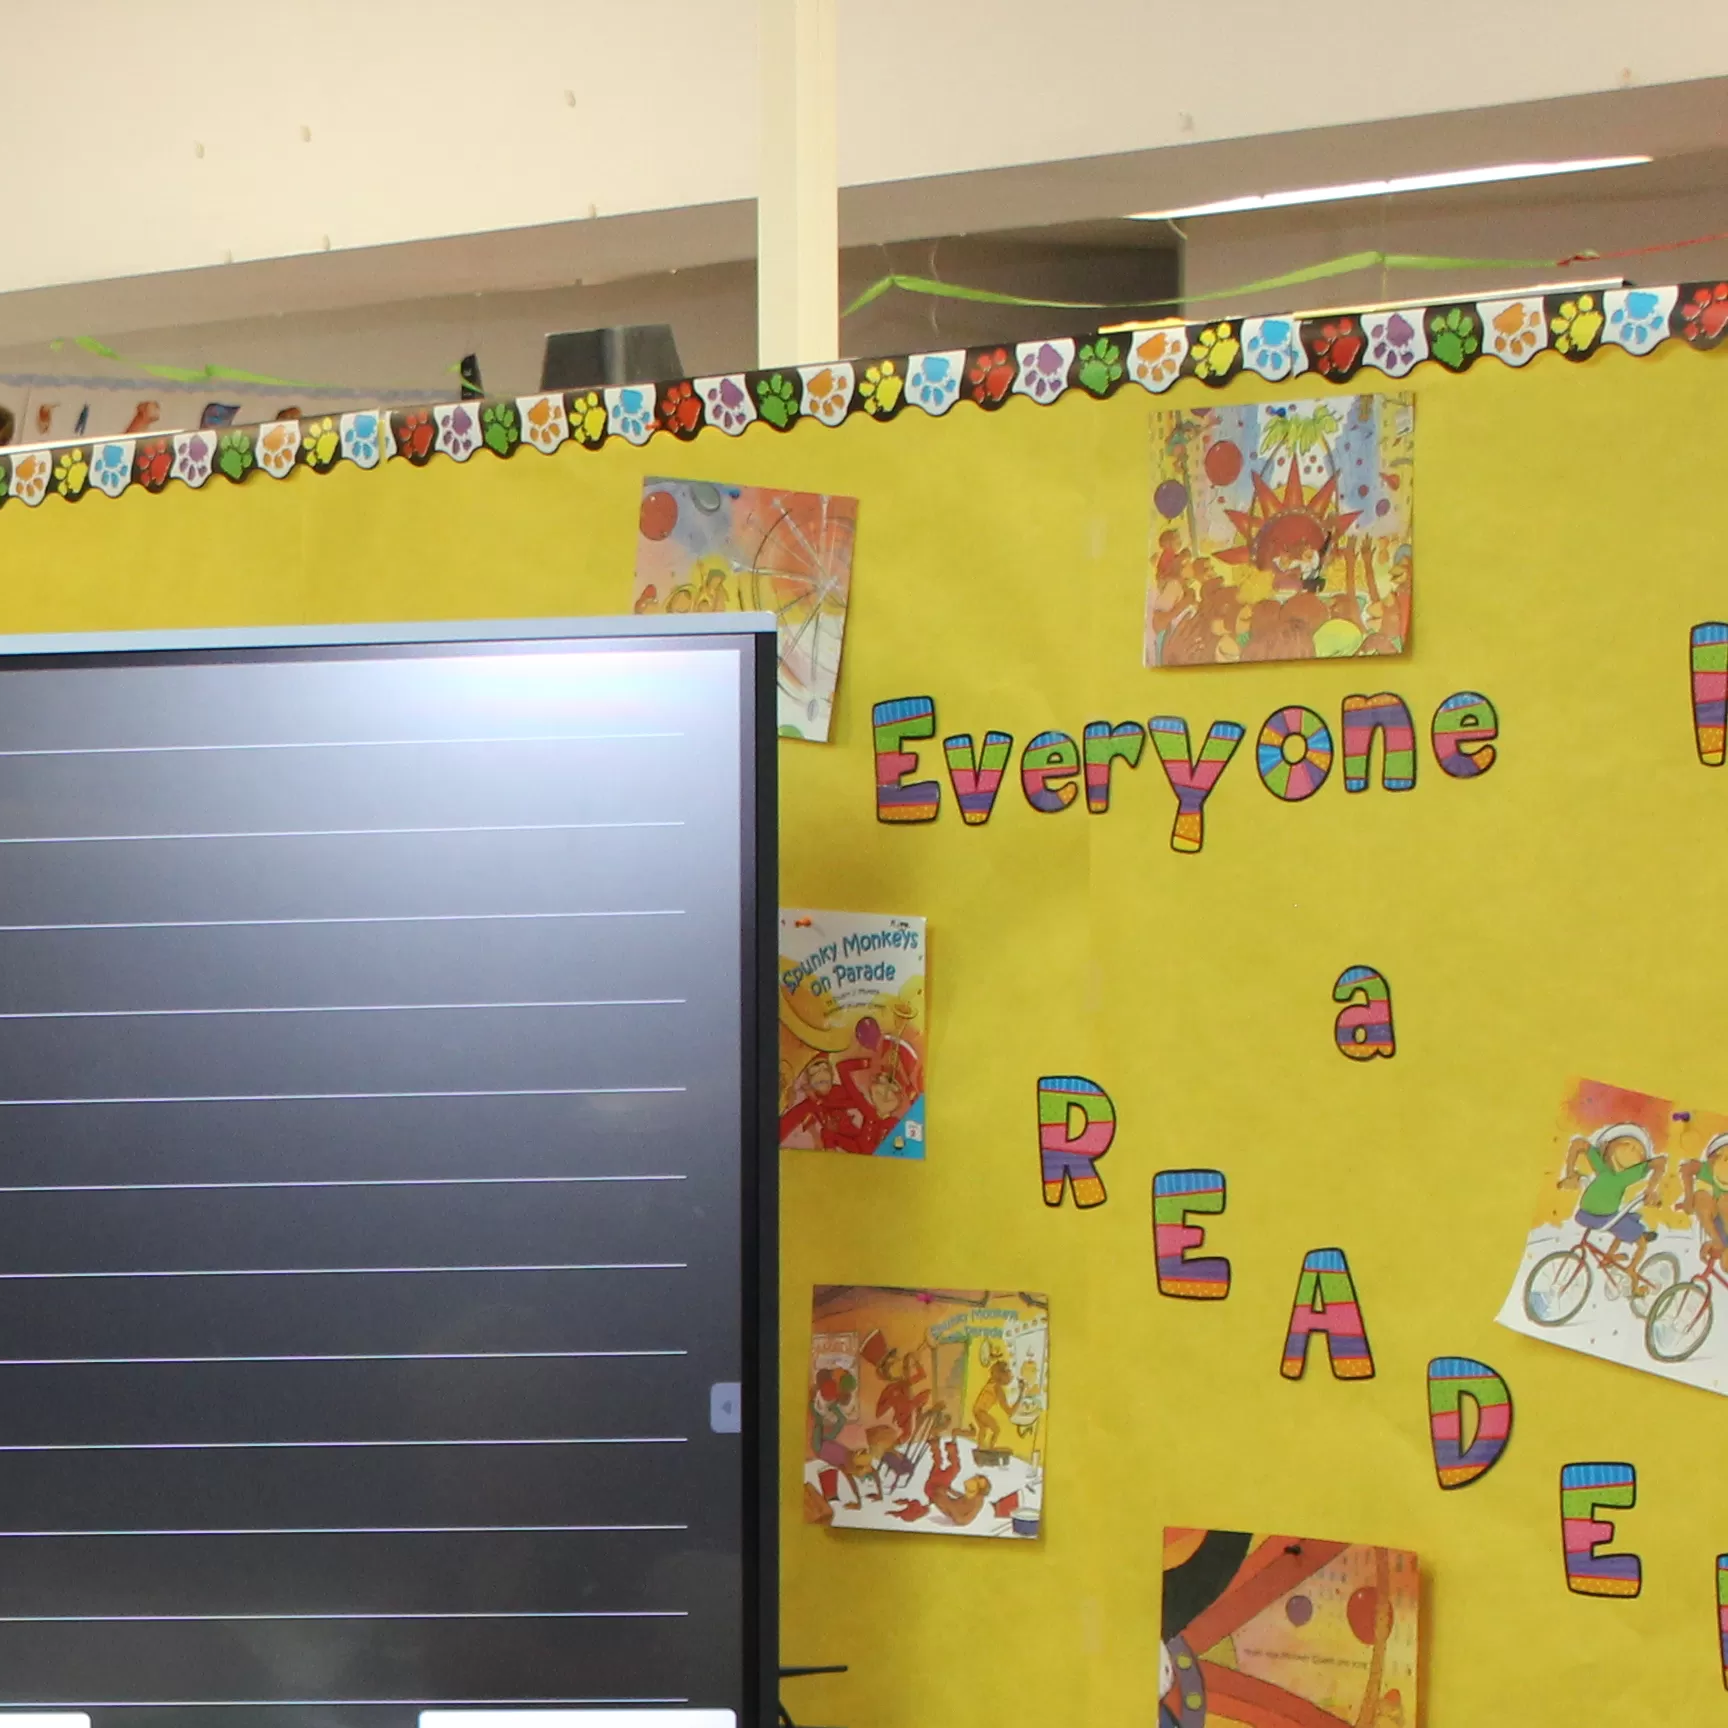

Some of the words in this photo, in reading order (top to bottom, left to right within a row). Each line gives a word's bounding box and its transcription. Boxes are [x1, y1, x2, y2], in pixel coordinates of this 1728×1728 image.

[872, 690, 1500, 854] Everyone
[782, 941, 838, 995] Spunky
[842, 929, 919, 958] Monkeys
[810, 976, 831, 996] on
[832, 961, 896, 988] Parade
[1332, 964, 1396, 1062] a
